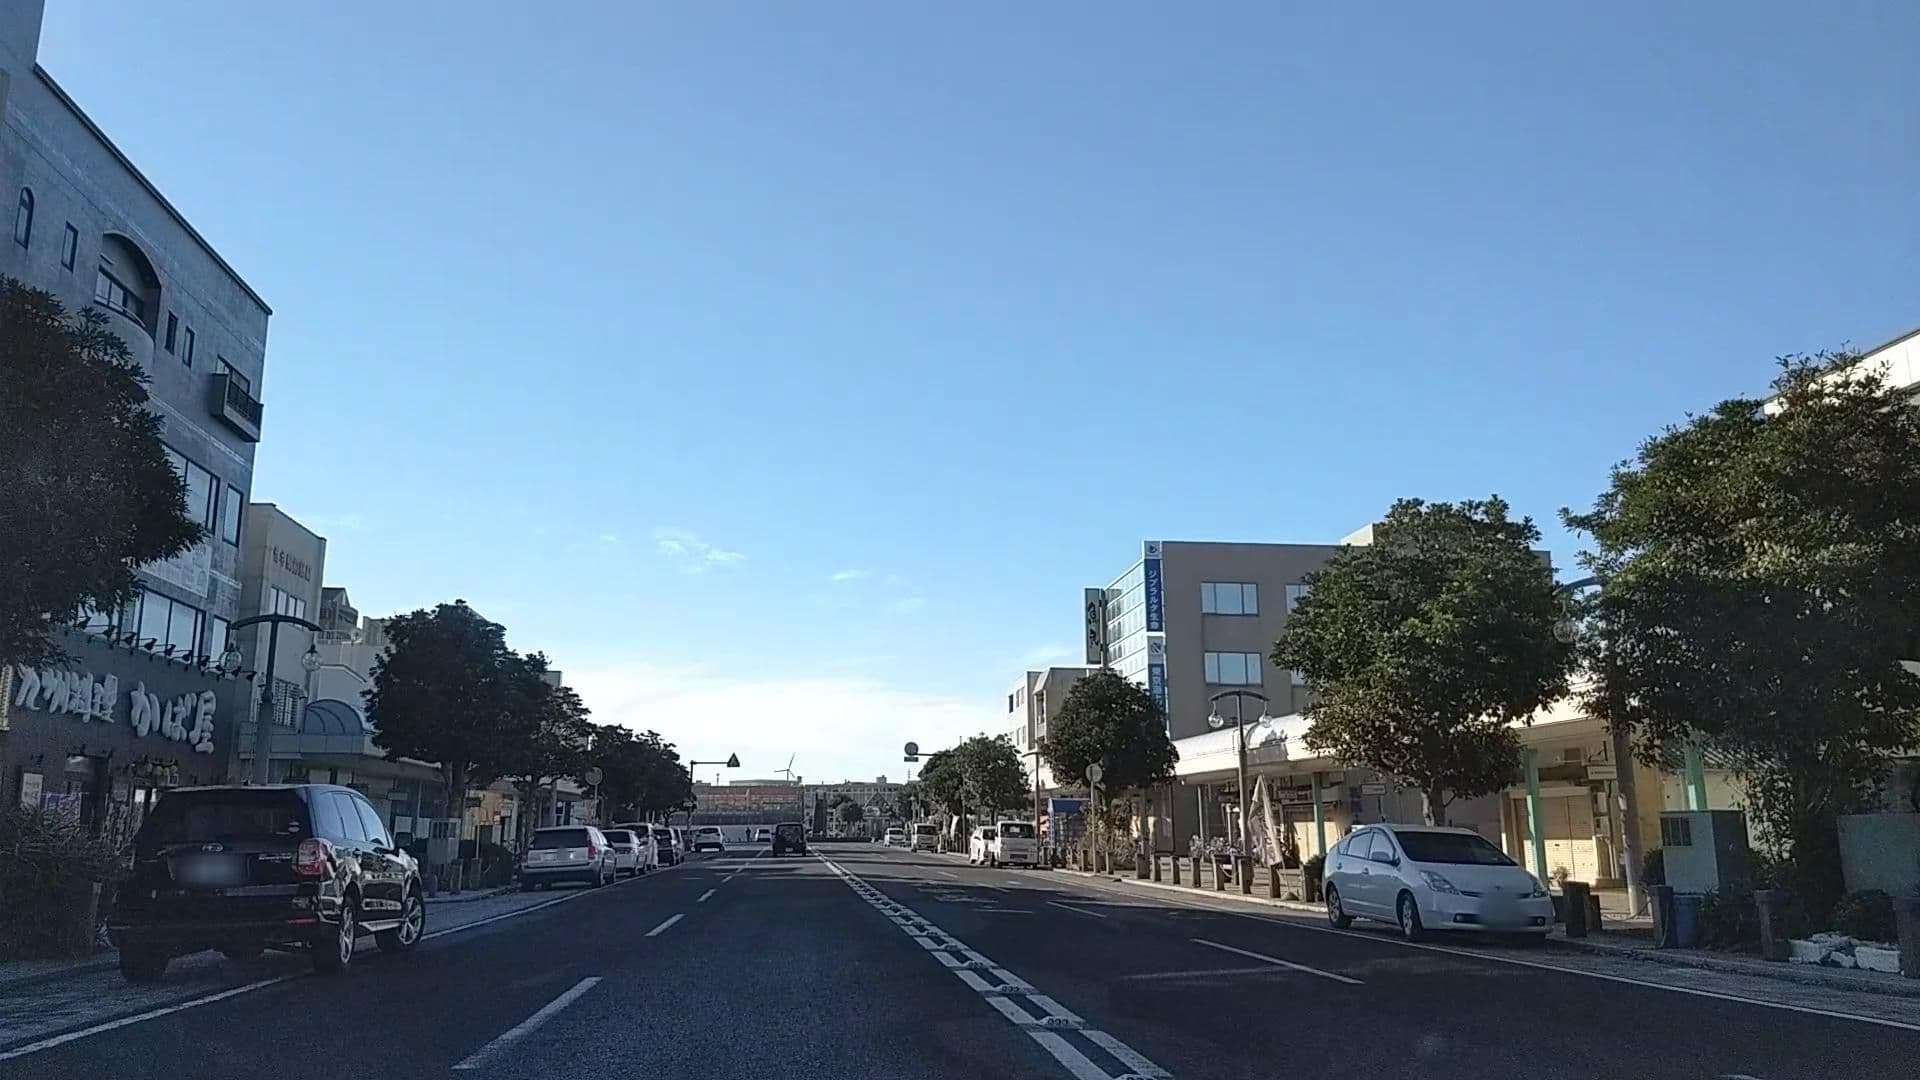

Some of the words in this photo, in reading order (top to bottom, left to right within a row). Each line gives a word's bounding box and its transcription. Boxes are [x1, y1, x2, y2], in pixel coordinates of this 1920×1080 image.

[1148, 569, 1160, 630] ジブラルタ生命
[15, 662, 119, 723] 九州料理
[130, 680, 217, 754] かば屋
